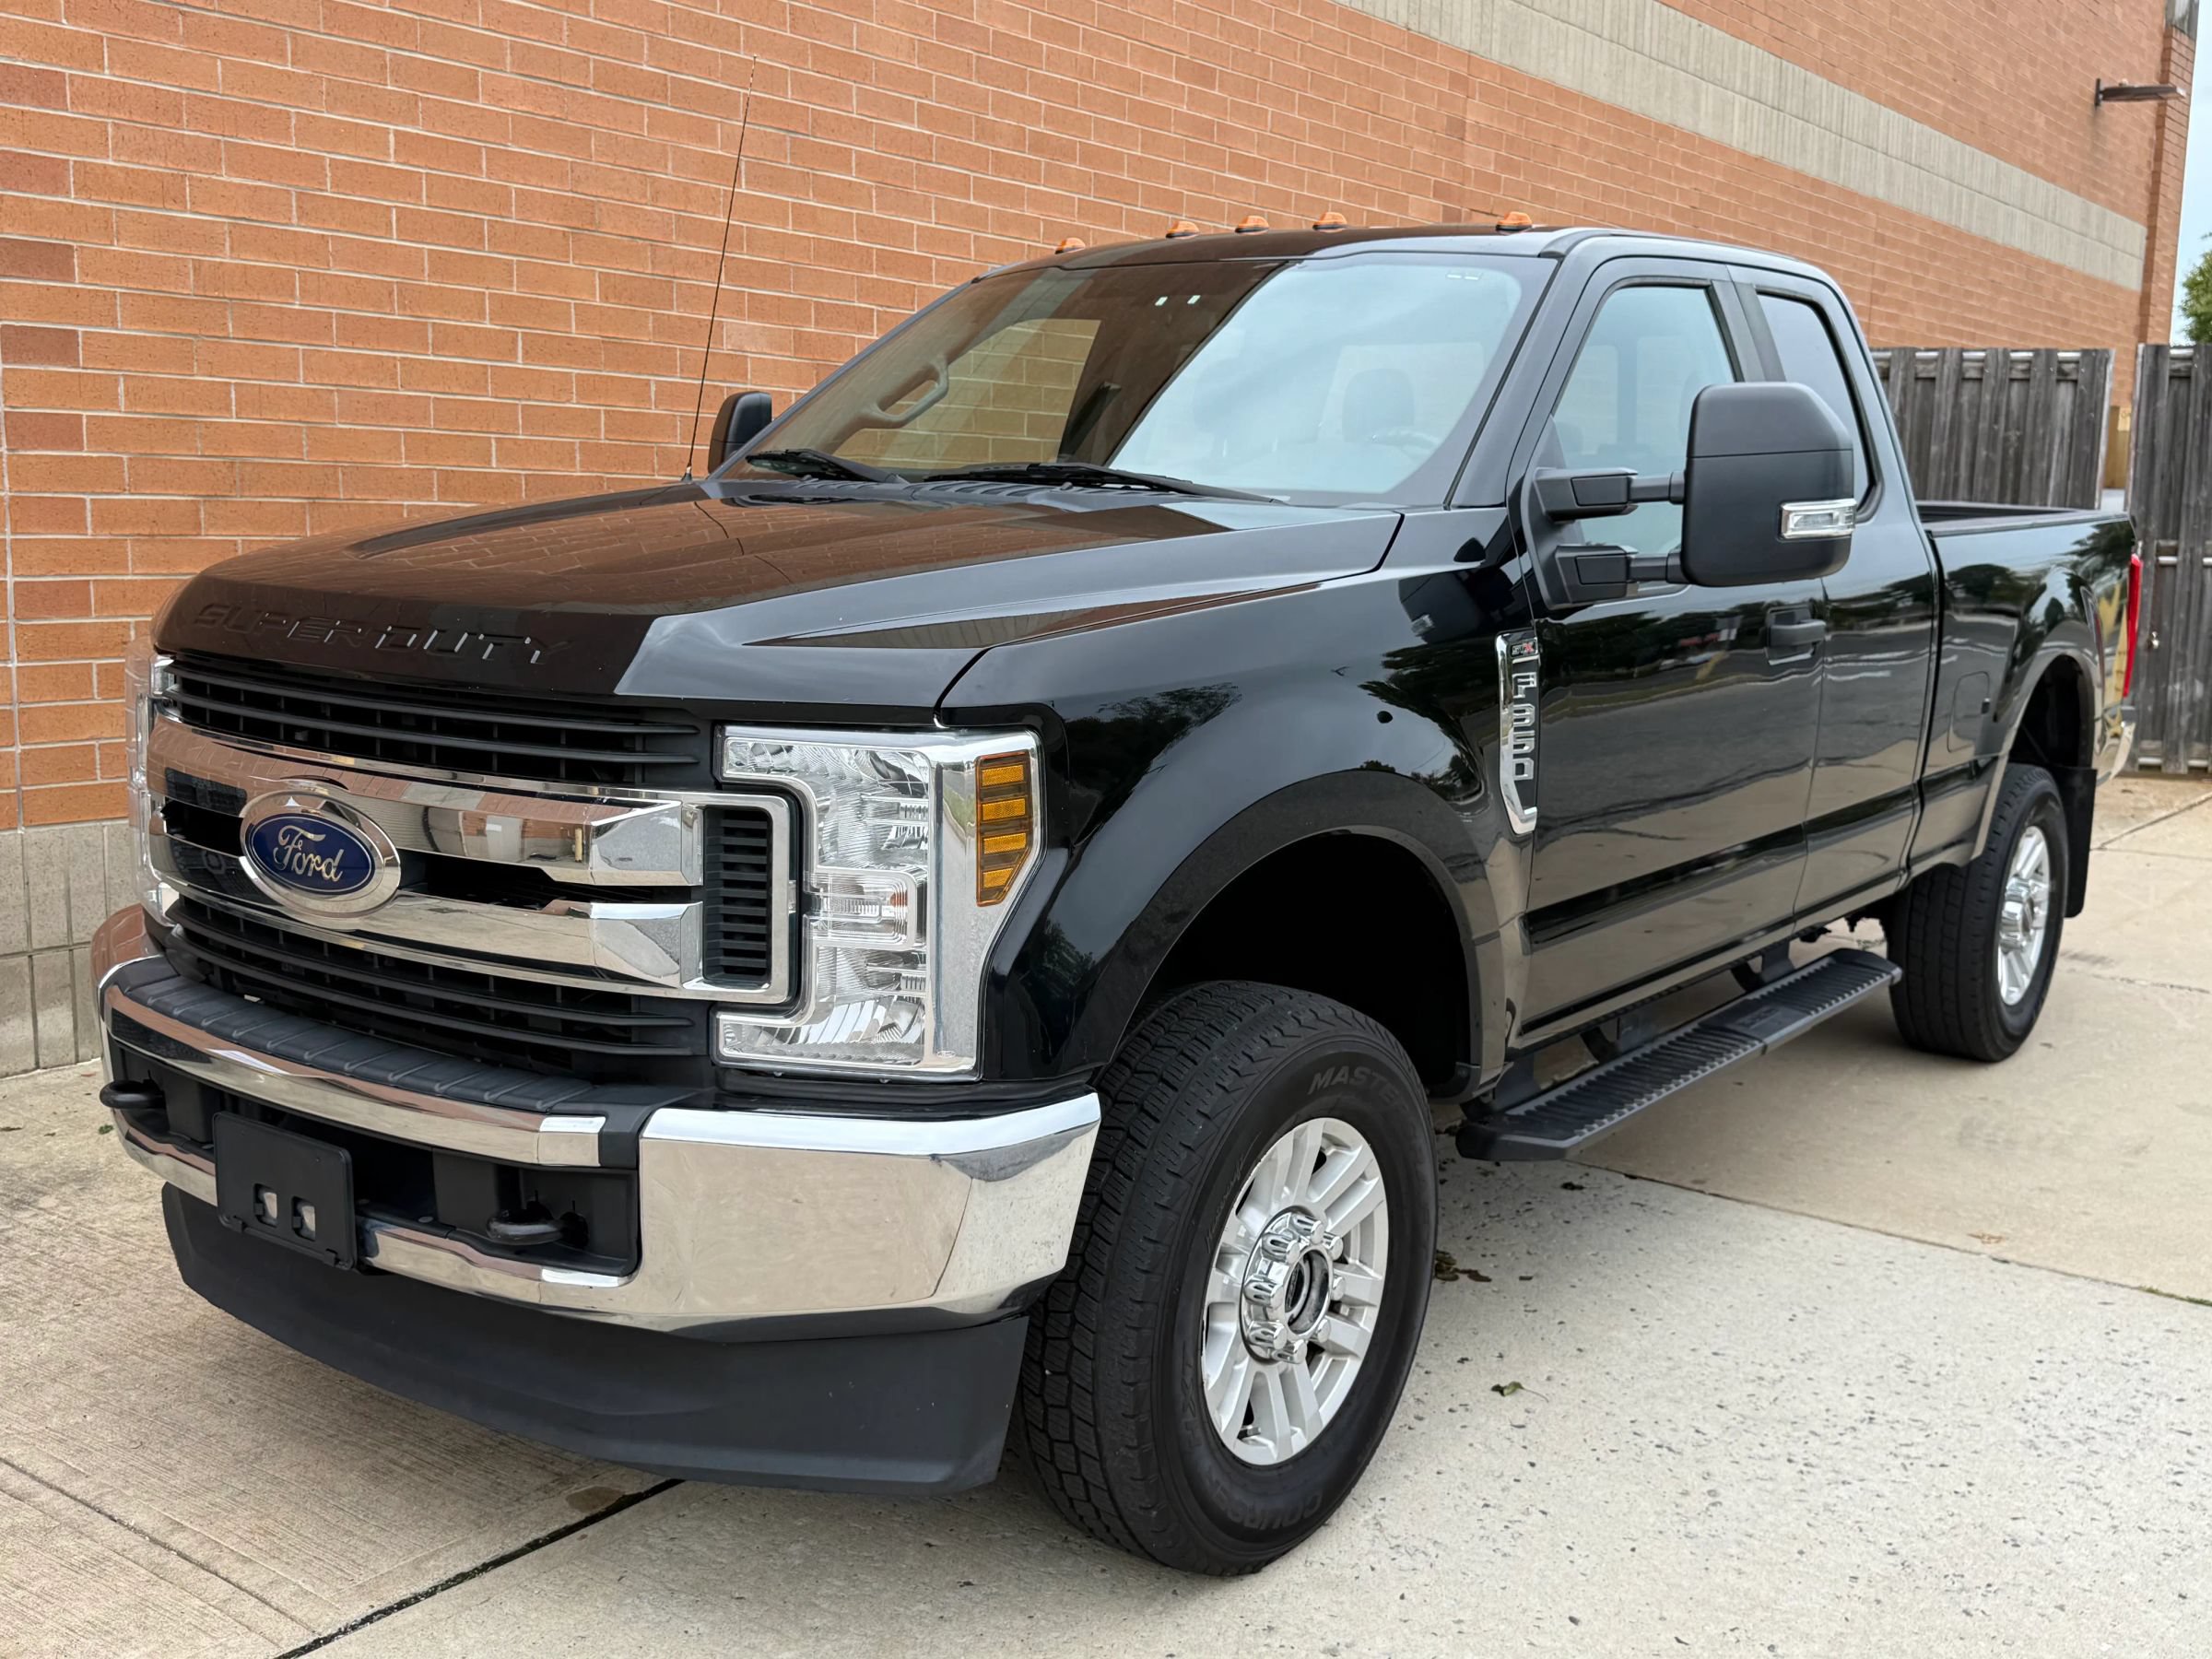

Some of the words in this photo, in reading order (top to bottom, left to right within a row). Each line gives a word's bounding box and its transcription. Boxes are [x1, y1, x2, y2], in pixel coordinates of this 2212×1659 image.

[194, 603, 371, 647] SUPER
[374, 625, 576, 665] DUTY
[1512, 672, 1537, 782] F350
[273, 824, 347, 882] Ford
